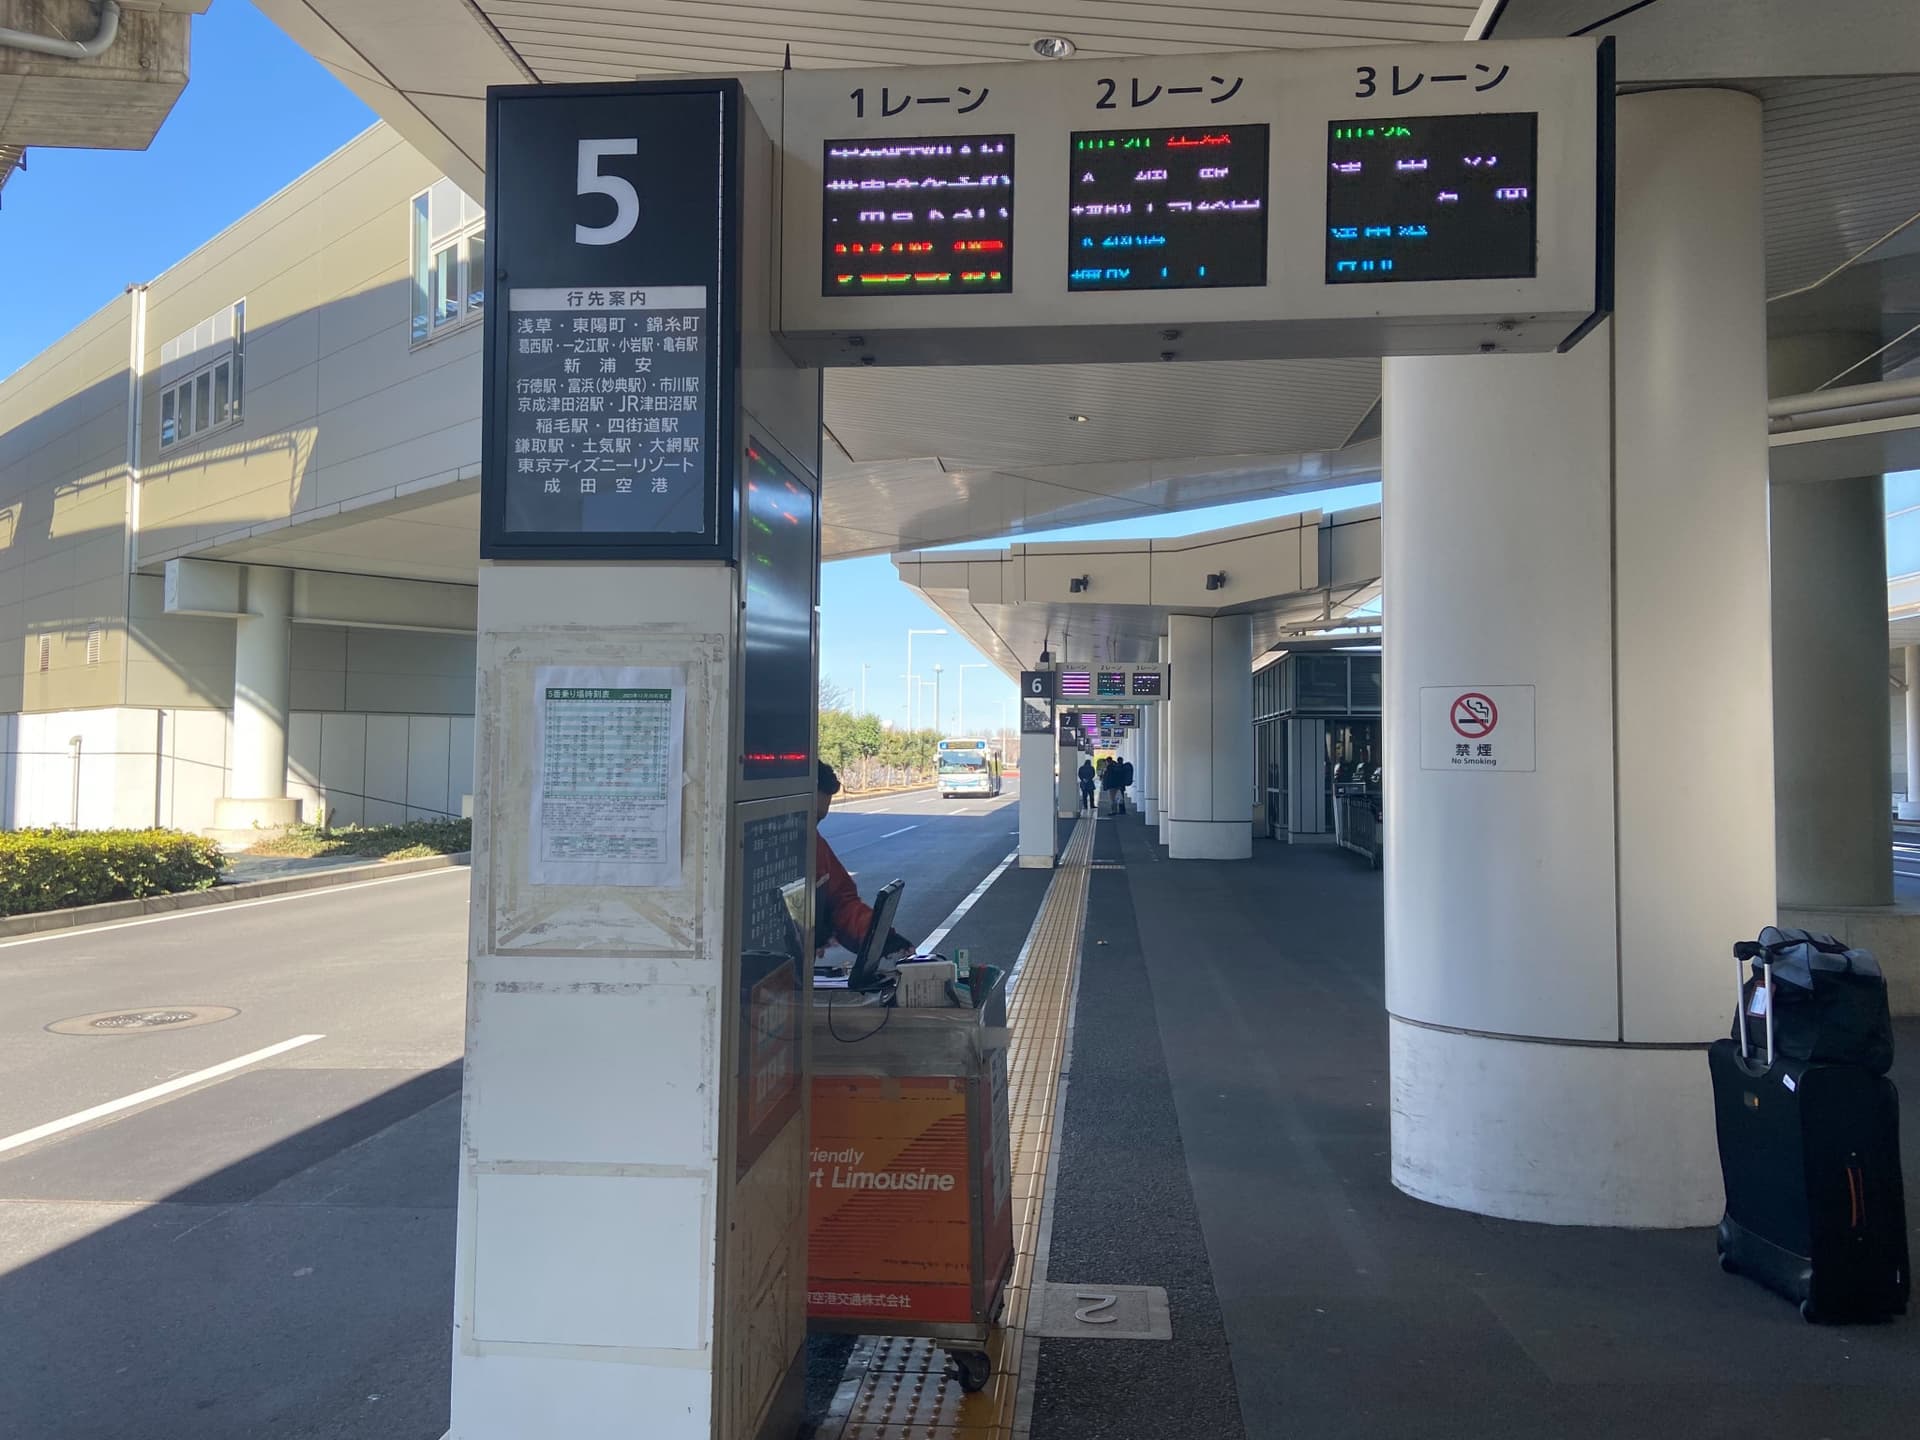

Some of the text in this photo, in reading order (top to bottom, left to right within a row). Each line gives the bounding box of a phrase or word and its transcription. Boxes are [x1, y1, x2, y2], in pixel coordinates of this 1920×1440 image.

[575, 138, 640, 246] 5
[567, 290, 647, 307] 行先案内
[517, 456, 695, 474] 東京ディズニーリゾート
[543, 477, 668, 494] 成田空港
[1031, 678, 1043, 693] 6
[1065, 716, 1071, 725] 7
[1456, 744, 1492, 756] 禁煙
[1452, 757, 1497, 766] No Smoking
[831, 1166, 955, 1191] Limousine
